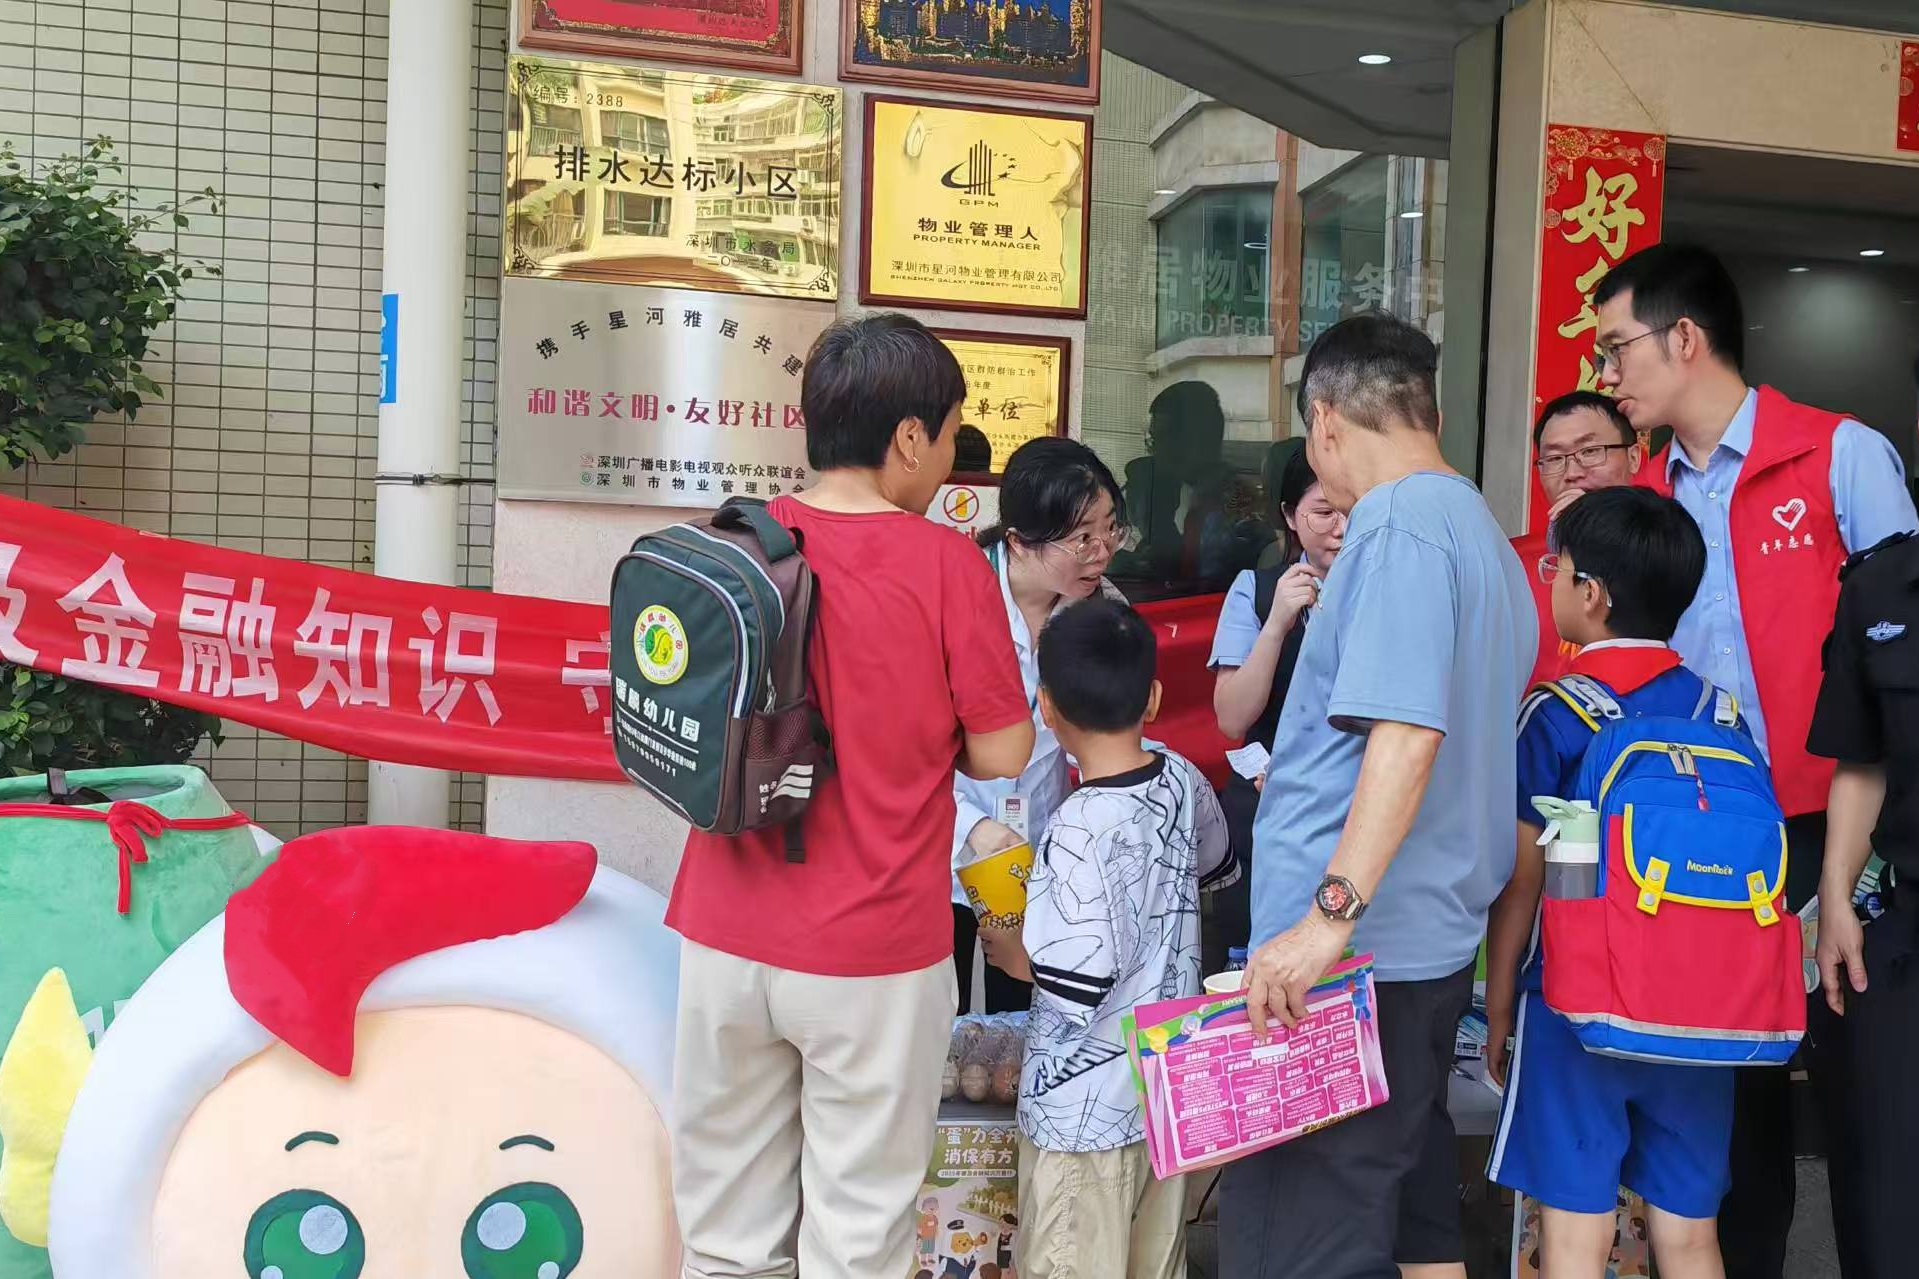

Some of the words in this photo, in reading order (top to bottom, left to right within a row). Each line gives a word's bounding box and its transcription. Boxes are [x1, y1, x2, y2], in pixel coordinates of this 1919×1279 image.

[554, 143, 798, 199] 排水达标小区
[958, 198, 999, 208] GPM
[917, 217, 1038, 241] 物业管理人
[684, 233, 796, 256] 深圳市水务局
[913, 233, 978, 246] PROPERTY
[981, 239, 1041, 251] MANAGER
[892, 259, 1062, 284] 深圳市星河物业管理有限公司
[1167, 309, 1291, 341] PROPERTY
[536, 306, 803, 377] 携手星河雅居共建
[974, 397, 1021, 421] 单位
[597, 455, 806, 480] 深圳广播电影电视观众听众联谊会
[944, 1147, 1014, 1165] 消保有方
